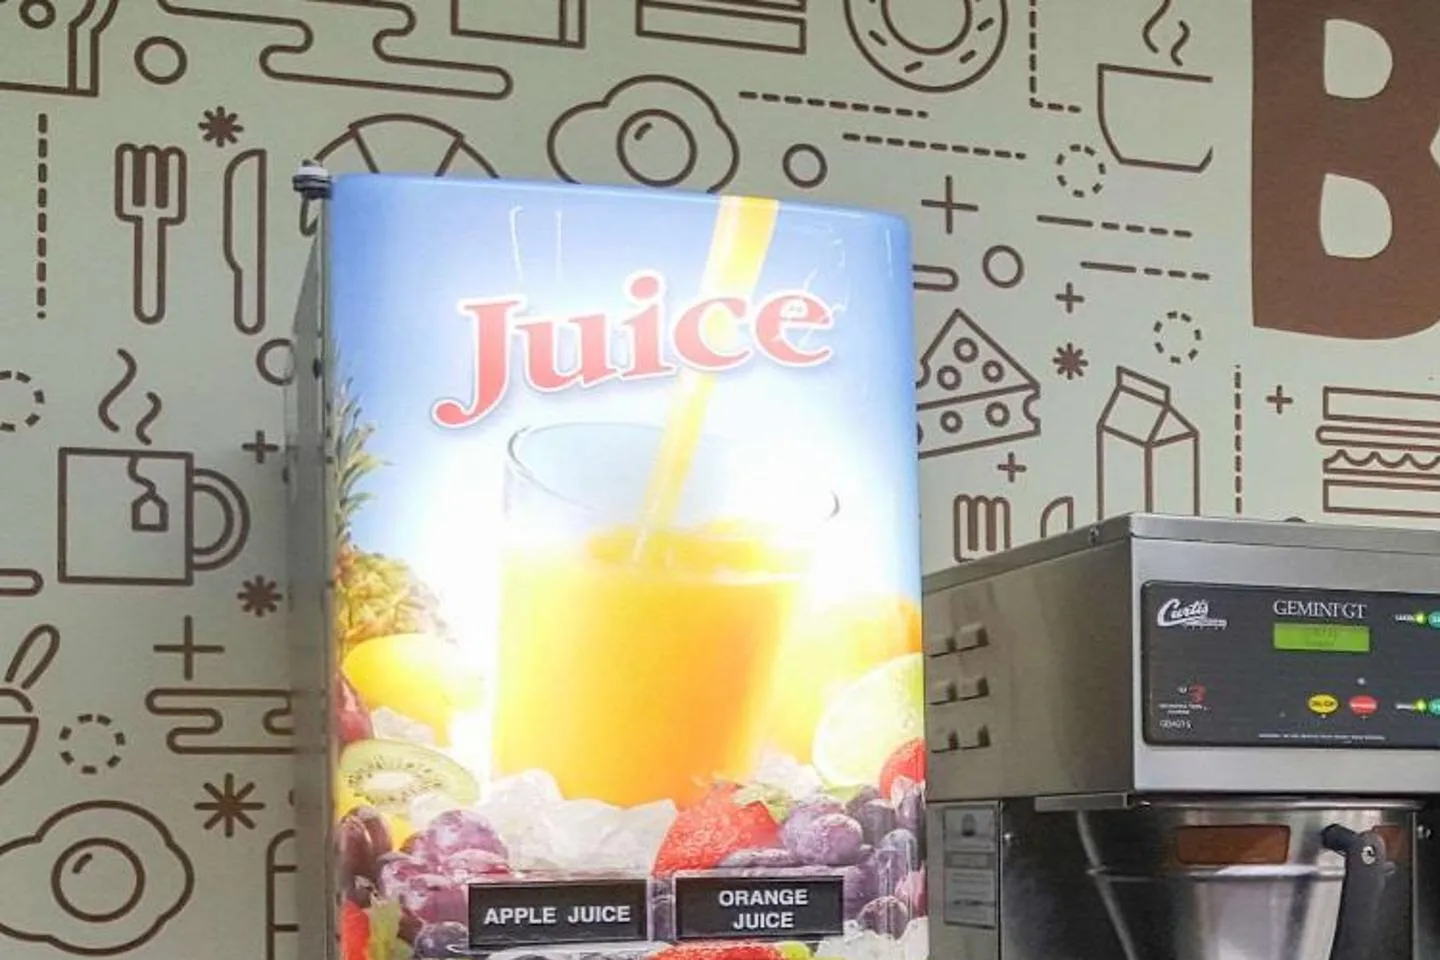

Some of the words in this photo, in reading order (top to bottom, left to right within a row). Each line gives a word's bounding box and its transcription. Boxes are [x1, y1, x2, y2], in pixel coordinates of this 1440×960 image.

[431, 270, 834, 427] Juice
[1157, 598, 1209, 627] Curtis
[1272, 600, 1338, 617] GEMINI
[1341, 603, 1369, 619] GT
[718, 888, 809, 908] ORANGE
[484, 906, 557, 926] APPLE
[567, 904, 632, 925] JUICE
[732, 911, 795, 931] JUICE
